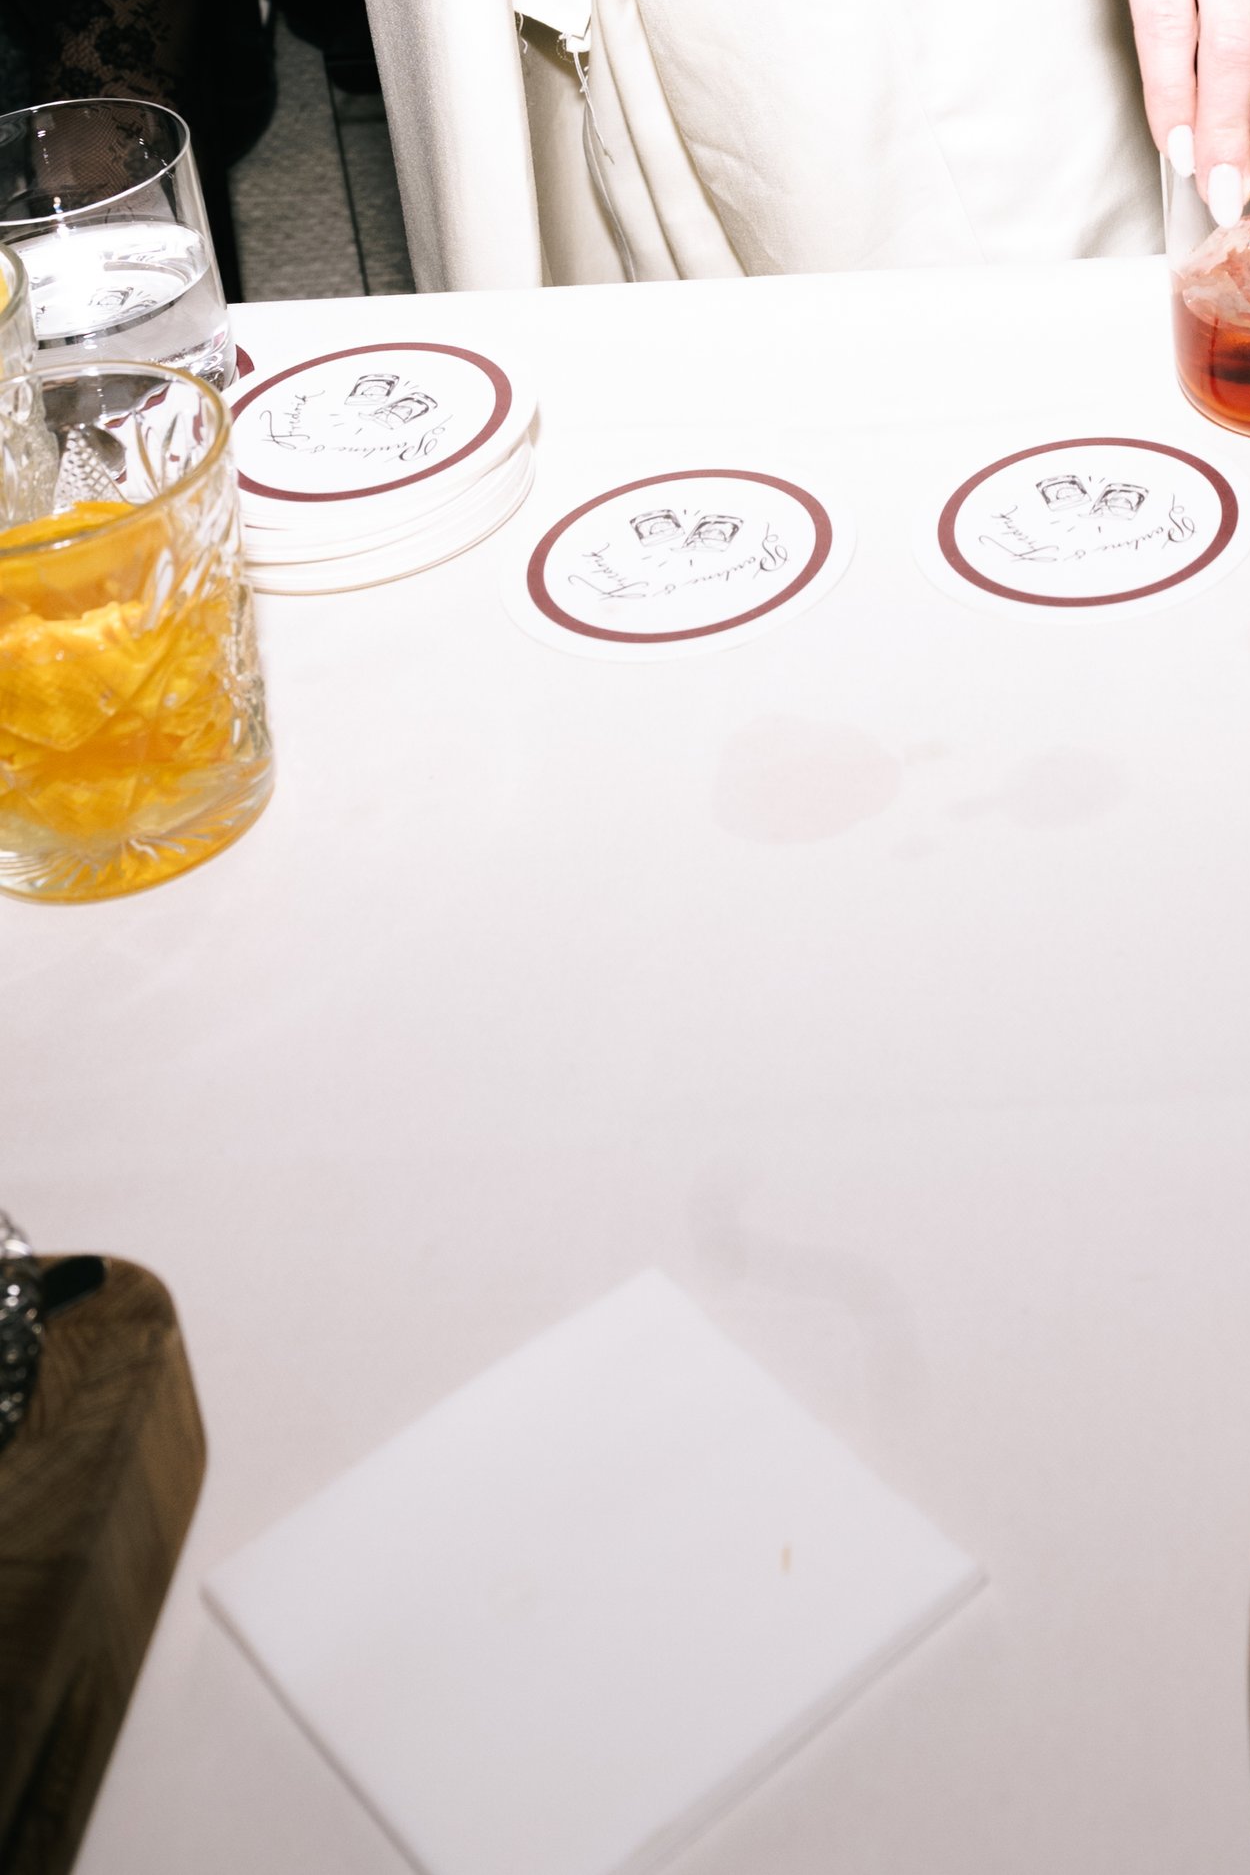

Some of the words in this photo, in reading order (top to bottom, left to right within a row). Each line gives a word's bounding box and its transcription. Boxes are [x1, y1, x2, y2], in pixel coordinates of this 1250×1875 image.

[332, 414, 454, 463] Pauline
[684, 522, 789, 586] Pauline
[1095, 493, 1197, 554] Pauline
